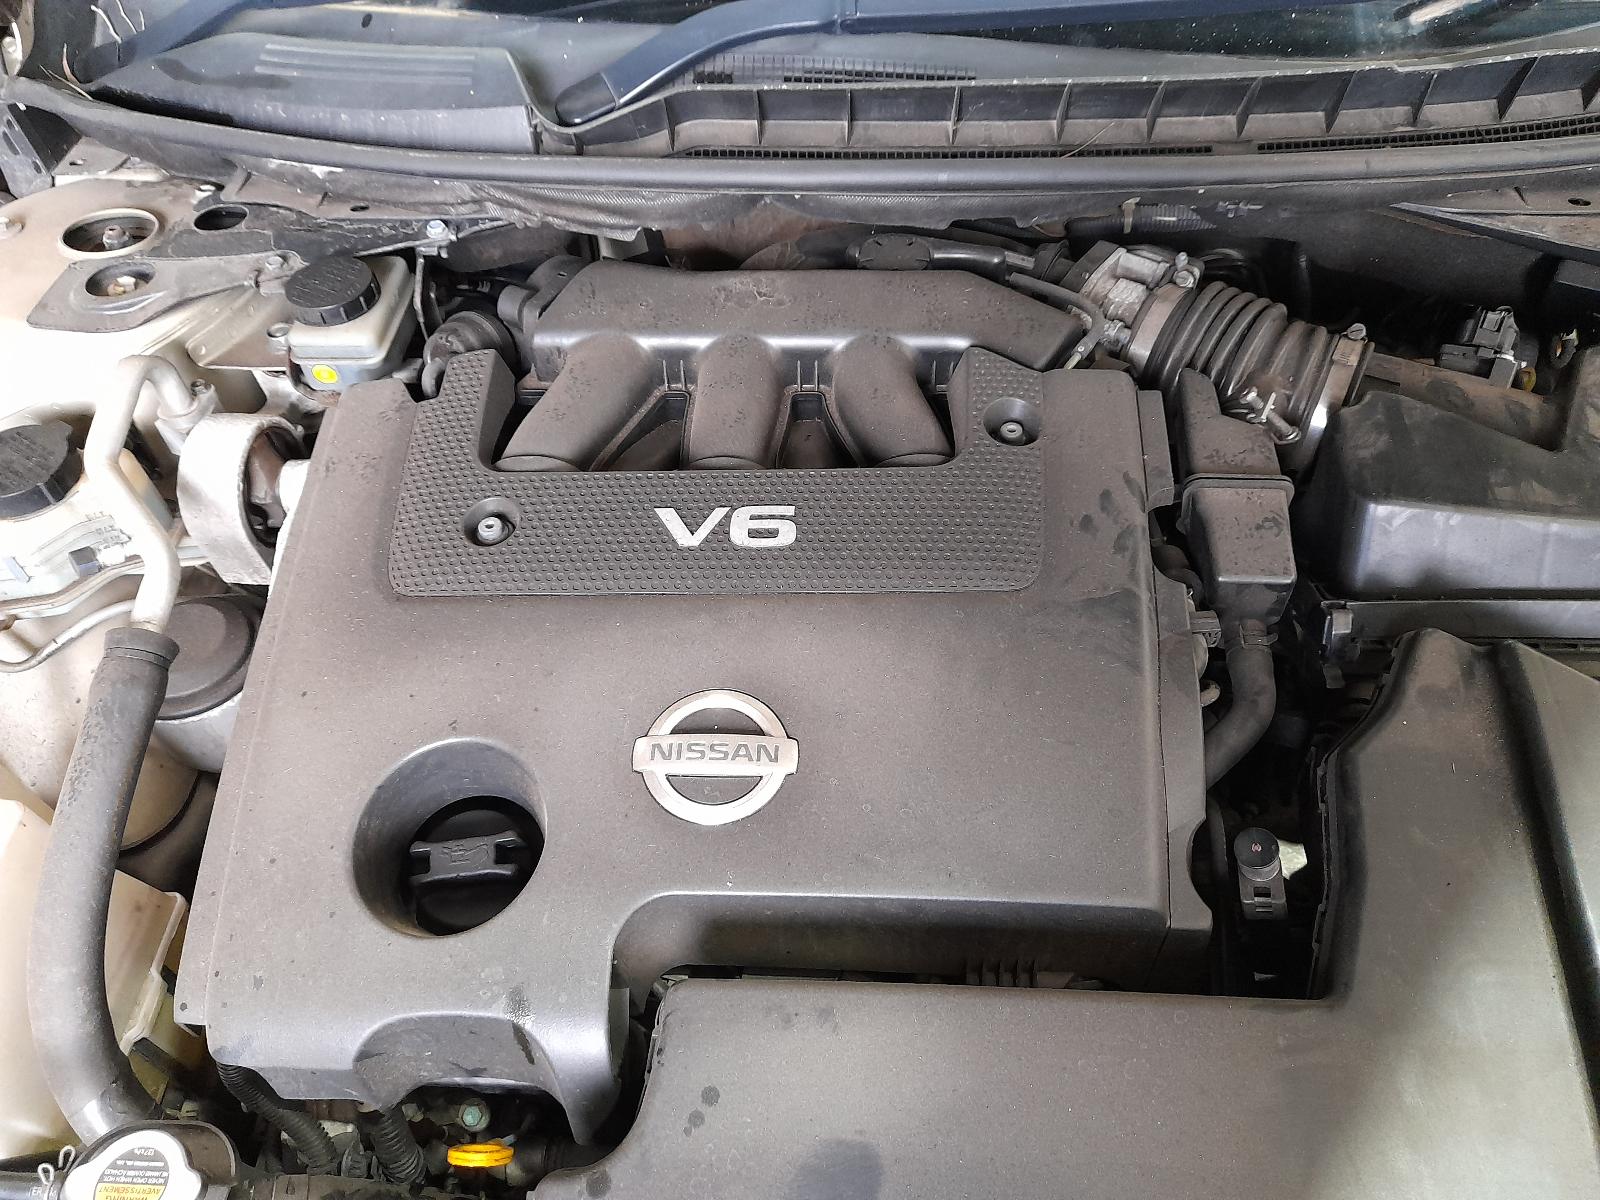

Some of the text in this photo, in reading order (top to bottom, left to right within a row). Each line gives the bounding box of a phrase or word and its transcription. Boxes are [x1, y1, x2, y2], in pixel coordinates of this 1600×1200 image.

[653, 505, 796, 547] V6
[650, 742, 779, 763] NISSAN
[99, 1186, 161, 1195] AVERTISSEMENT
